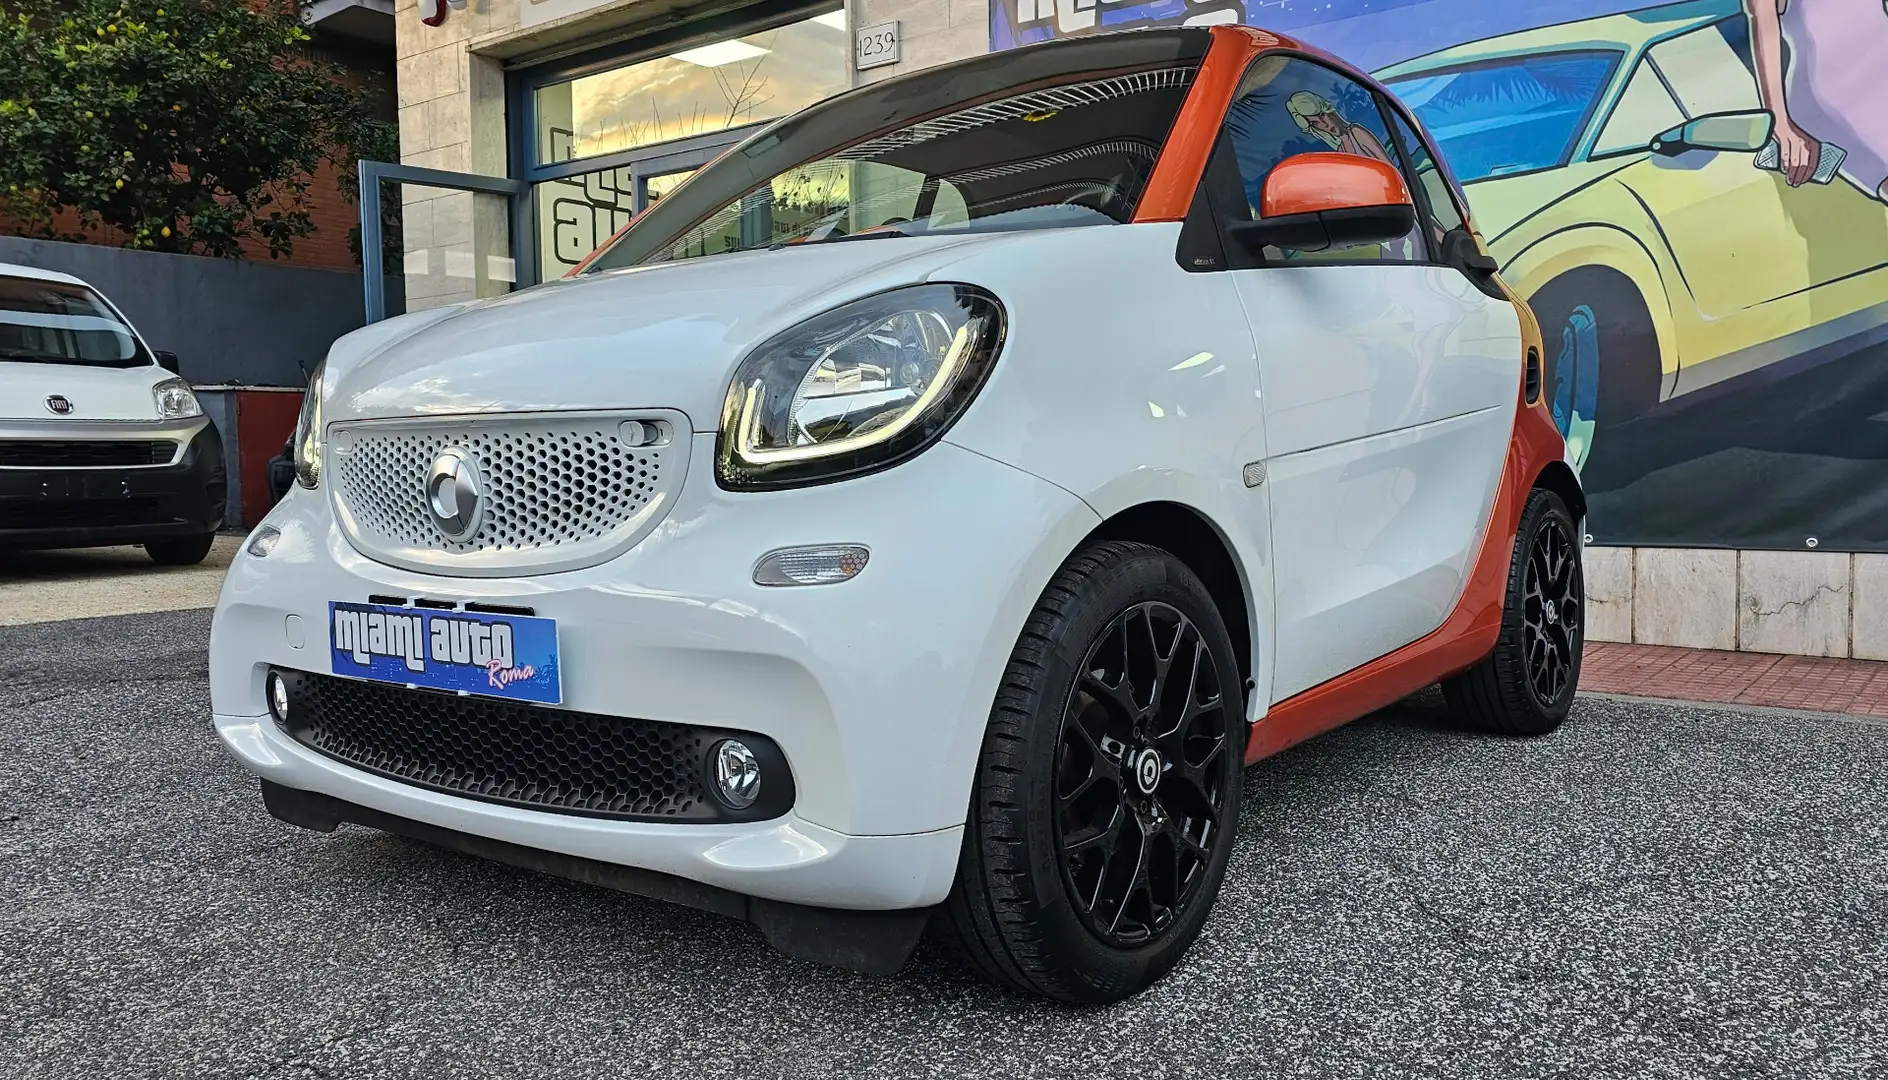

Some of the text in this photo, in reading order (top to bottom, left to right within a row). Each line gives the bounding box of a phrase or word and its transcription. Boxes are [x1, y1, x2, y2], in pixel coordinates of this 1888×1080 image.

[859, 31, 894, 57] 1239
[50, 399, 68, 409] FIAT
[485, 658, 535, 690] Roma
